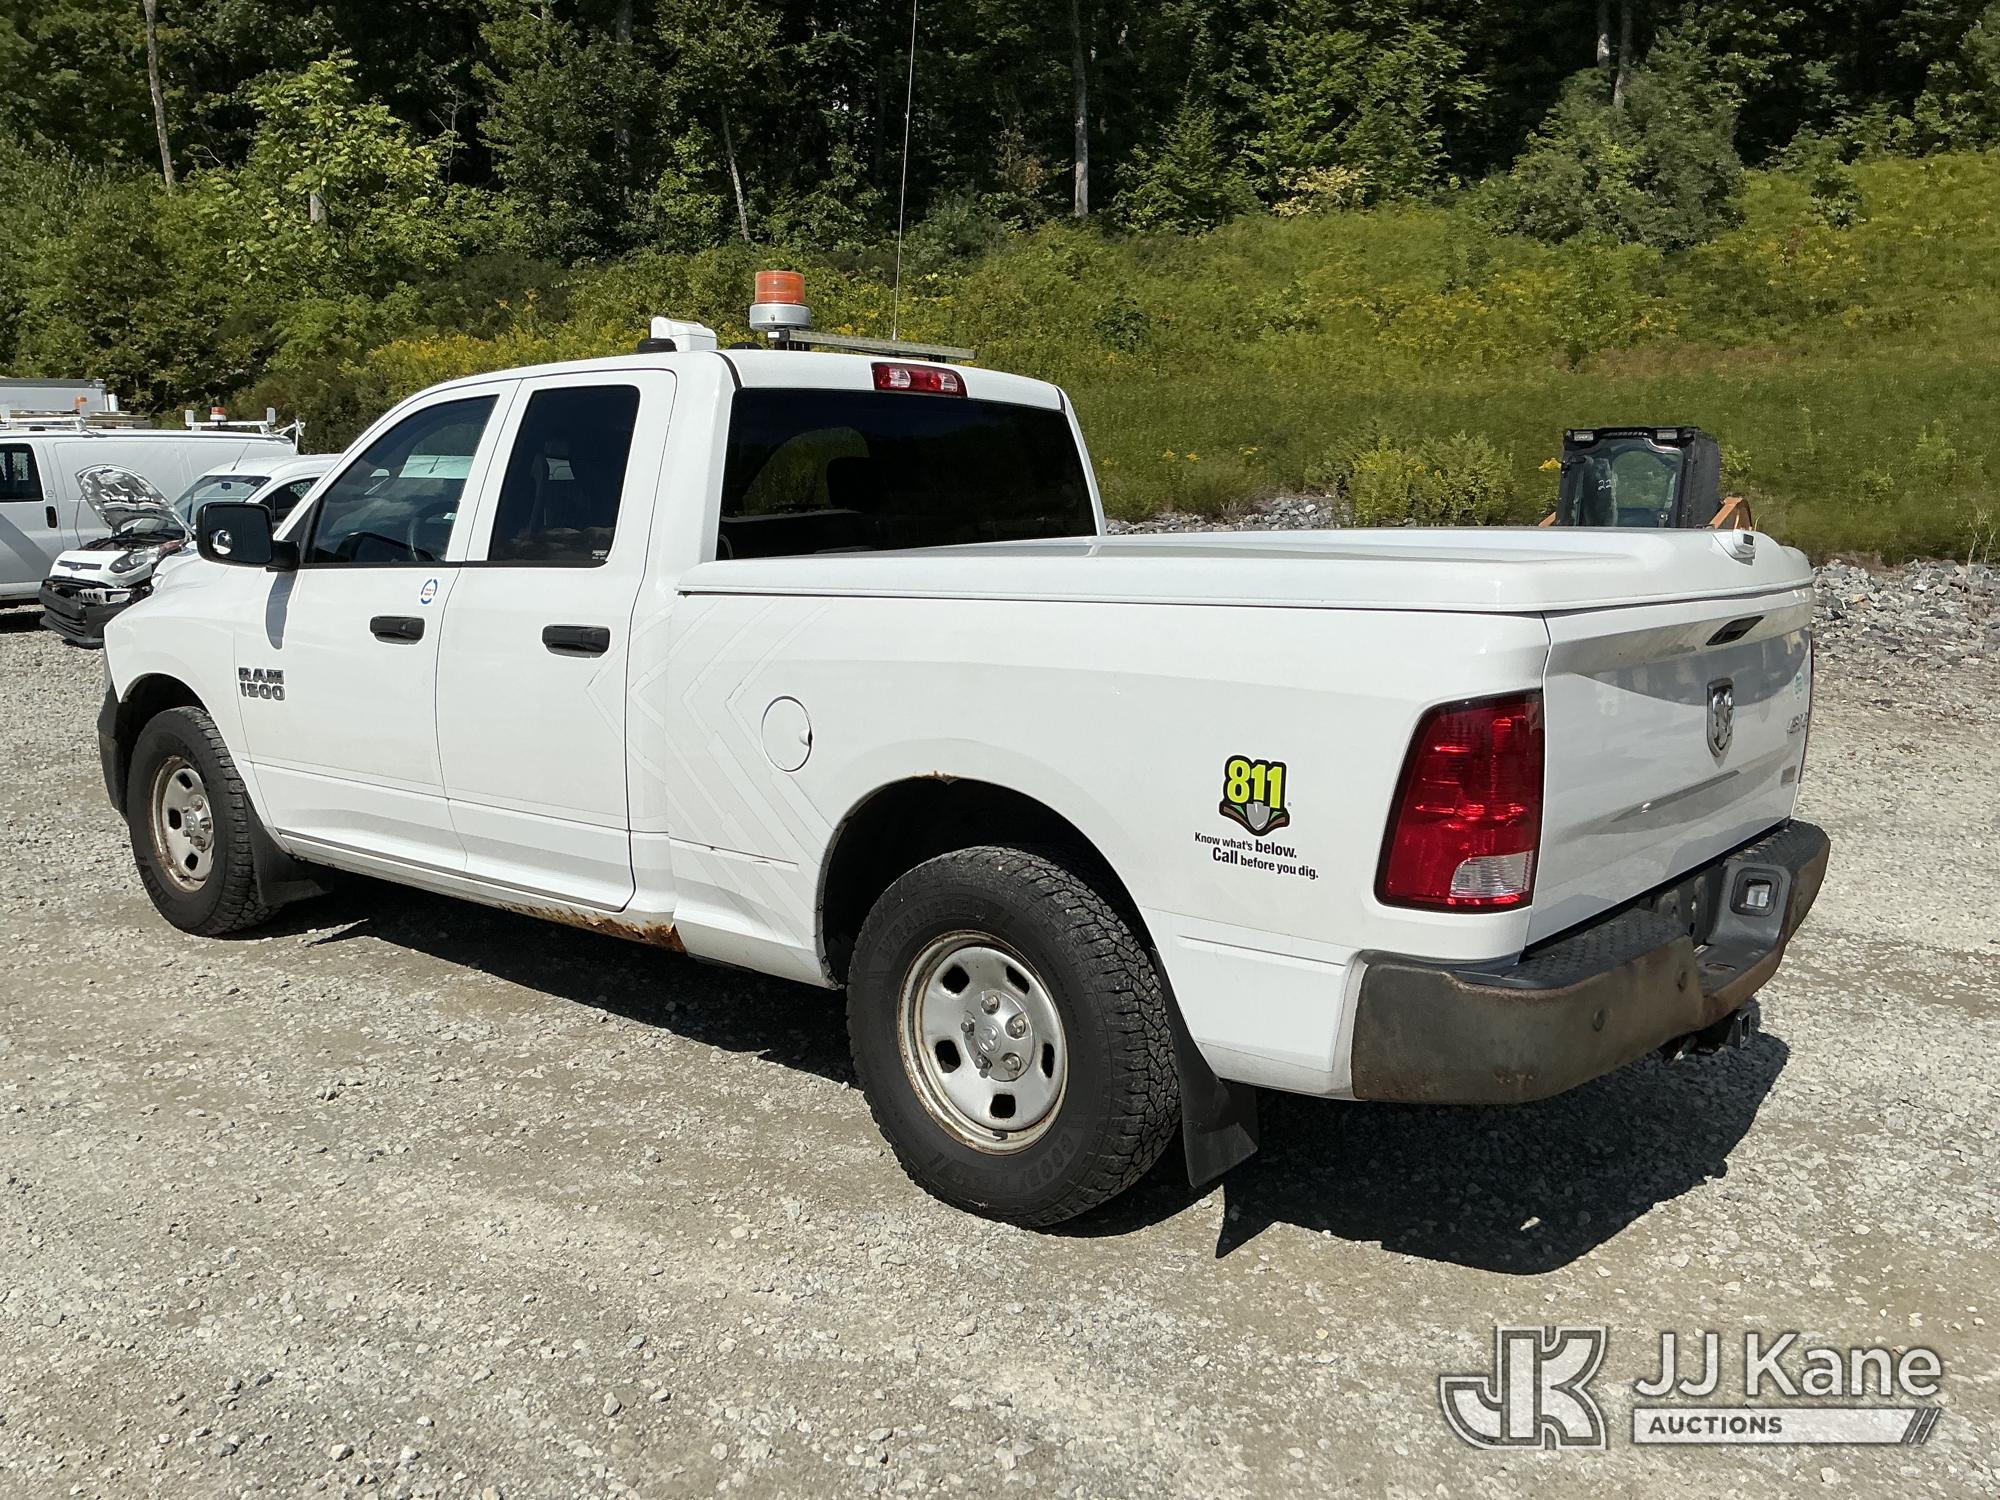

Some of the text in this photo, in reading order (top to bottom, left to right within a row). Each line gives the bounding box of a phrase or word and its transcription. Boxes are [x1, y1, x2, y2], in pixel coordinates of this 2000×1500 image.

[239, 667, 284, 685] RAM
[240, 682, 285, 701] 1500
[1226, 759, 1282, 809] 811
[1195, 832, 1297, 858] Know what's below.
[1212, 847, 1319, 880] Call before you dig.
